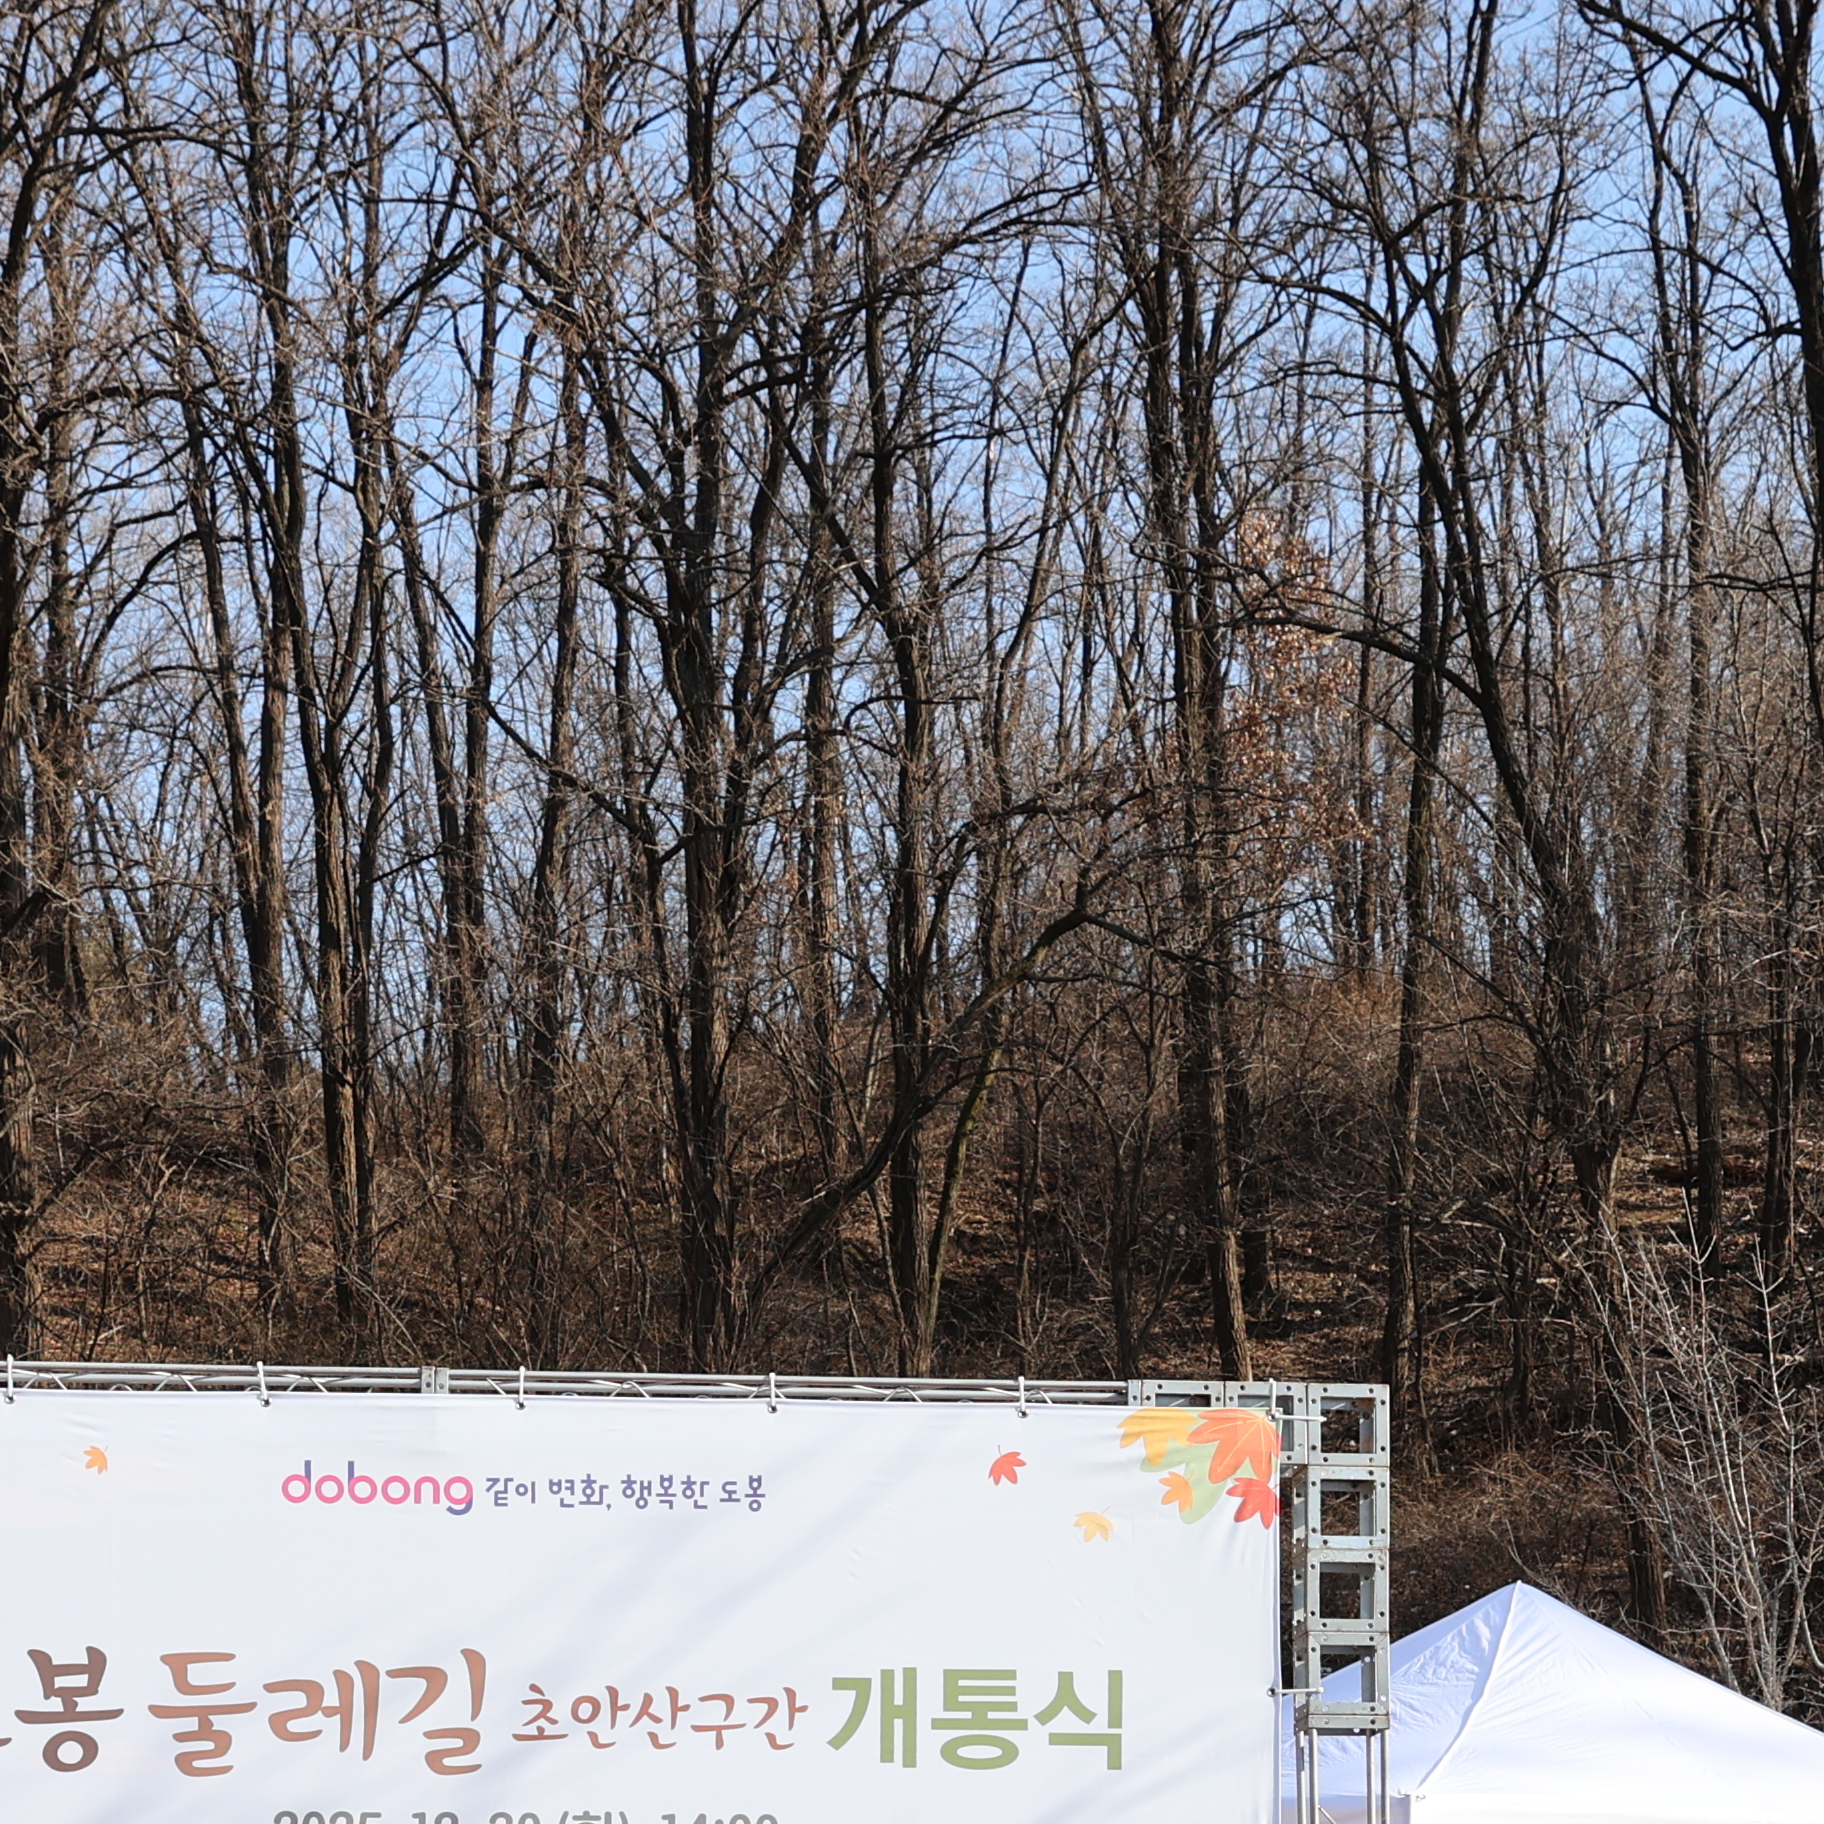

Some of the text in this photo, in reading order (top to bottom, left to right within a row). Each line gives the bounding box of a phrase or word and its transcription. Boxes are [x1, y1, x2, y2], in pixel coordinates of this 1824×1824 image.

[282, 1460, 765, 1515] dobong 같이 변화, 행복한 도봉
[148, 1649, 486, 1777] 둘레길
[512, 1684, 808, 1750] 초안산구간
[827, 1668, 1122, 1770] 개통식
